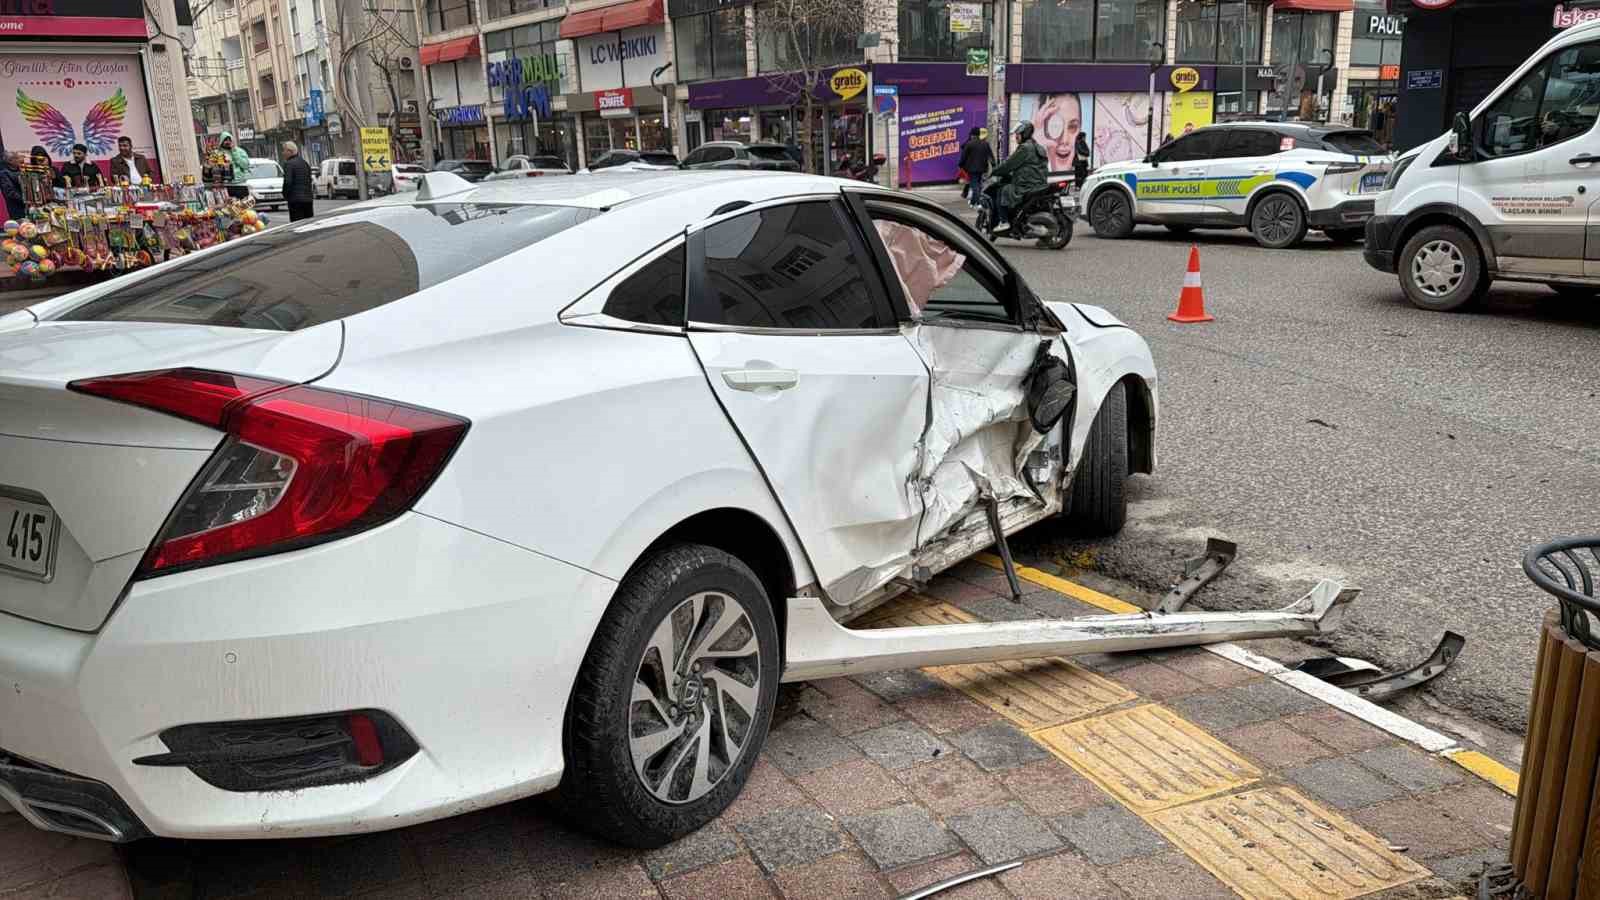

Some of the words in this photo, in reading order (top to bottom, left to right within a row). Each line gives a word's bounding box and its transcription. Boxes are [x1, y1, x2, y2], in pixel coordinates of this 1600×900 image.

[1370, 15, 1402, 34] PAUL
[835, 72, 862, 90] gratis
[1175, 71, 1196, 84] gratis
[7, 510, 46, 562] 415
